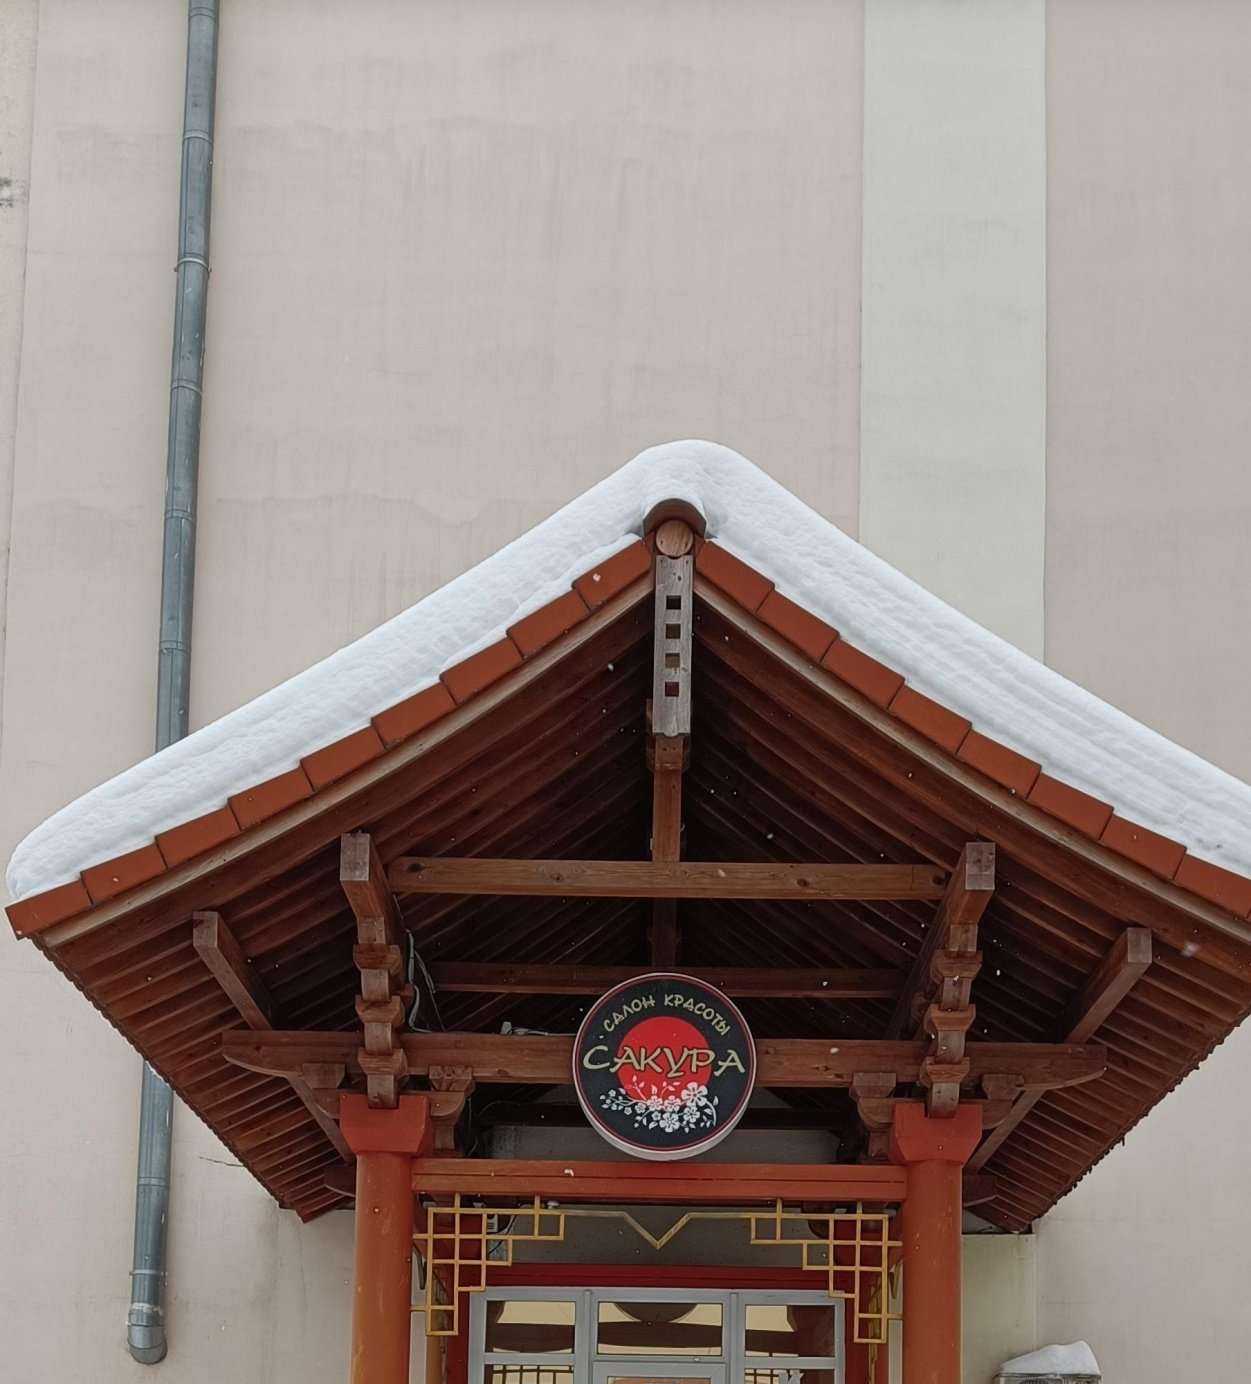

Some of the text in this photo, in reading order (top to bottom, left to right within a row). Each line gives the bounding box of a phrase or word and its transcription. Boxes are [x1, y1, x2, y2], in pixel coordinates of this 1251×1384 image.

[604, 994, 731, 1036] САЛОН КРАСОТЫ
[583, 1045, 746, 1078] САКУРА
